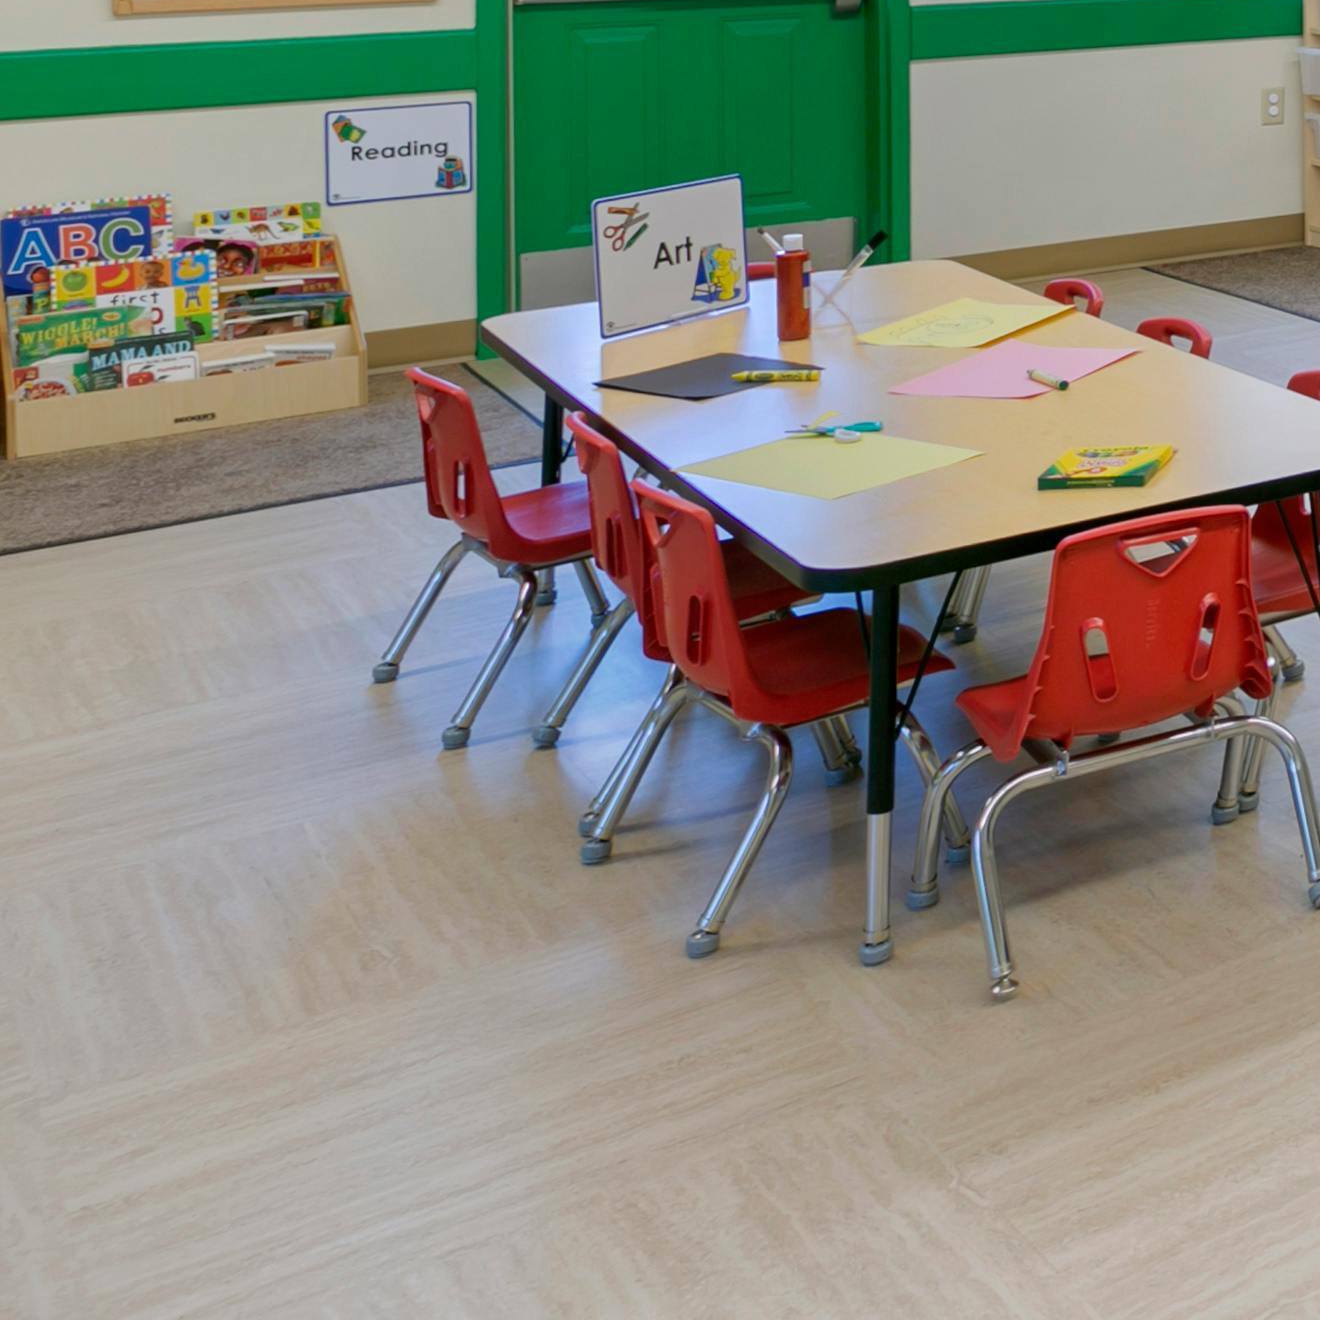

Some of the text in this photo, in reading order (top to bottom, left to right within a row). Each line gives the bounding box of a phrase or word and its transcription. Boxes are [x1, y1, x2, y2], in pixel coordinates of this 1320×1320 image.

[351, 140, 449, 162] Reading
[6, 216, 145, 276] ABC
[652, 235, 694, 270] Art
[109, 290, 161, 306] first
[20, 316, 98, 347] WIGGLE!
[90, 340, 192, 372] MAMA AND
